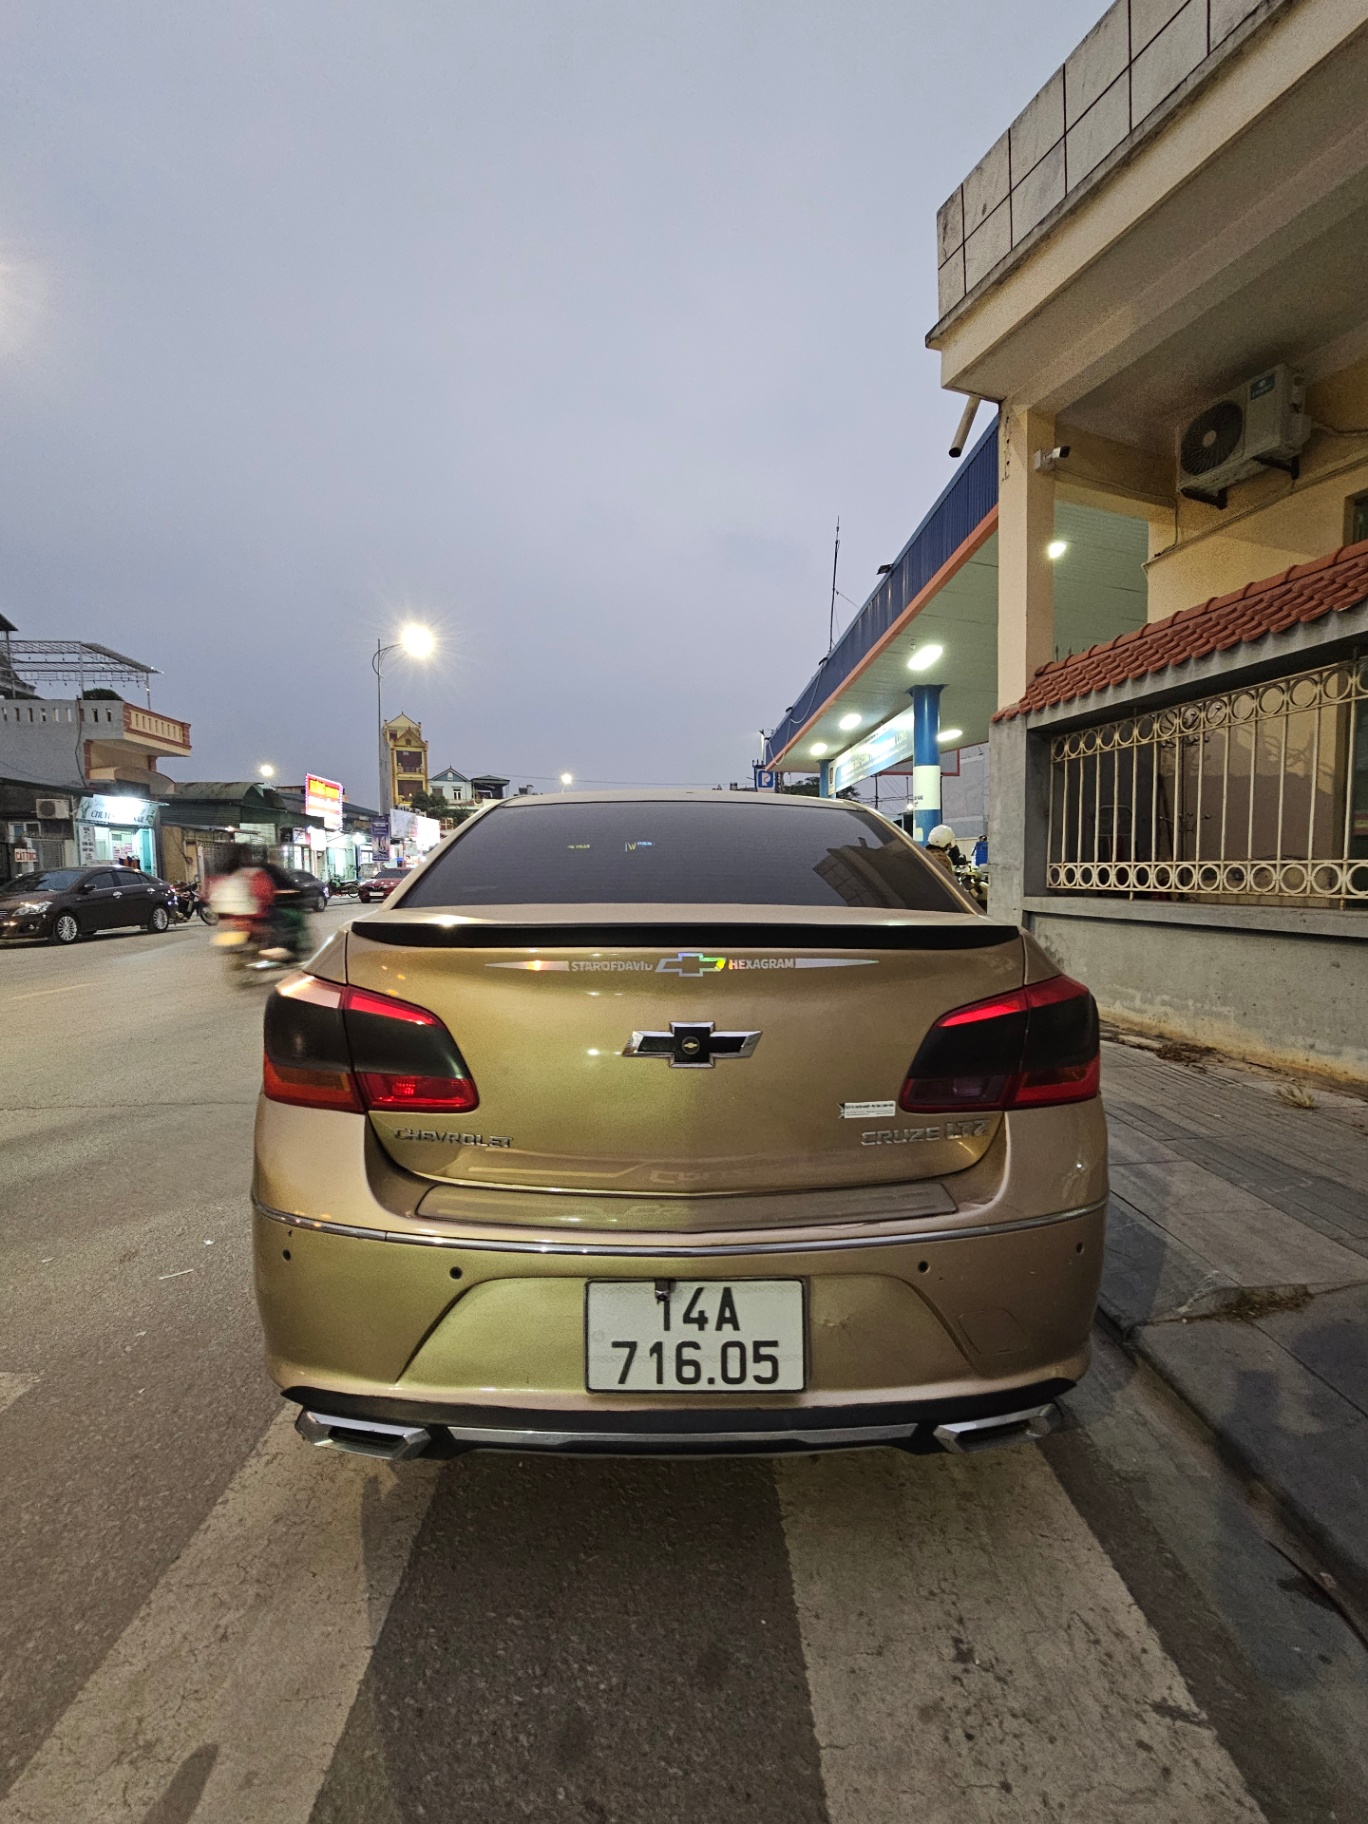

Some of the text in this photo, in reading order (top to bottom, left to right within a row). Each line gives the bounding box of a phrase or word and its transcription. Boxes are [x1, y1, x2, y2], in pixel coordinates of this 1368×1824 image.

[728, 959, 794, 970] HEXAGRAM
[394, 1127, 513, 1148] CHEVROLET
[861, 1119, 990, 1146] CRUZE LTZ
[657, 1287, 741, 1331] 14A
[611, 1340, 779, 1385] 716.05
